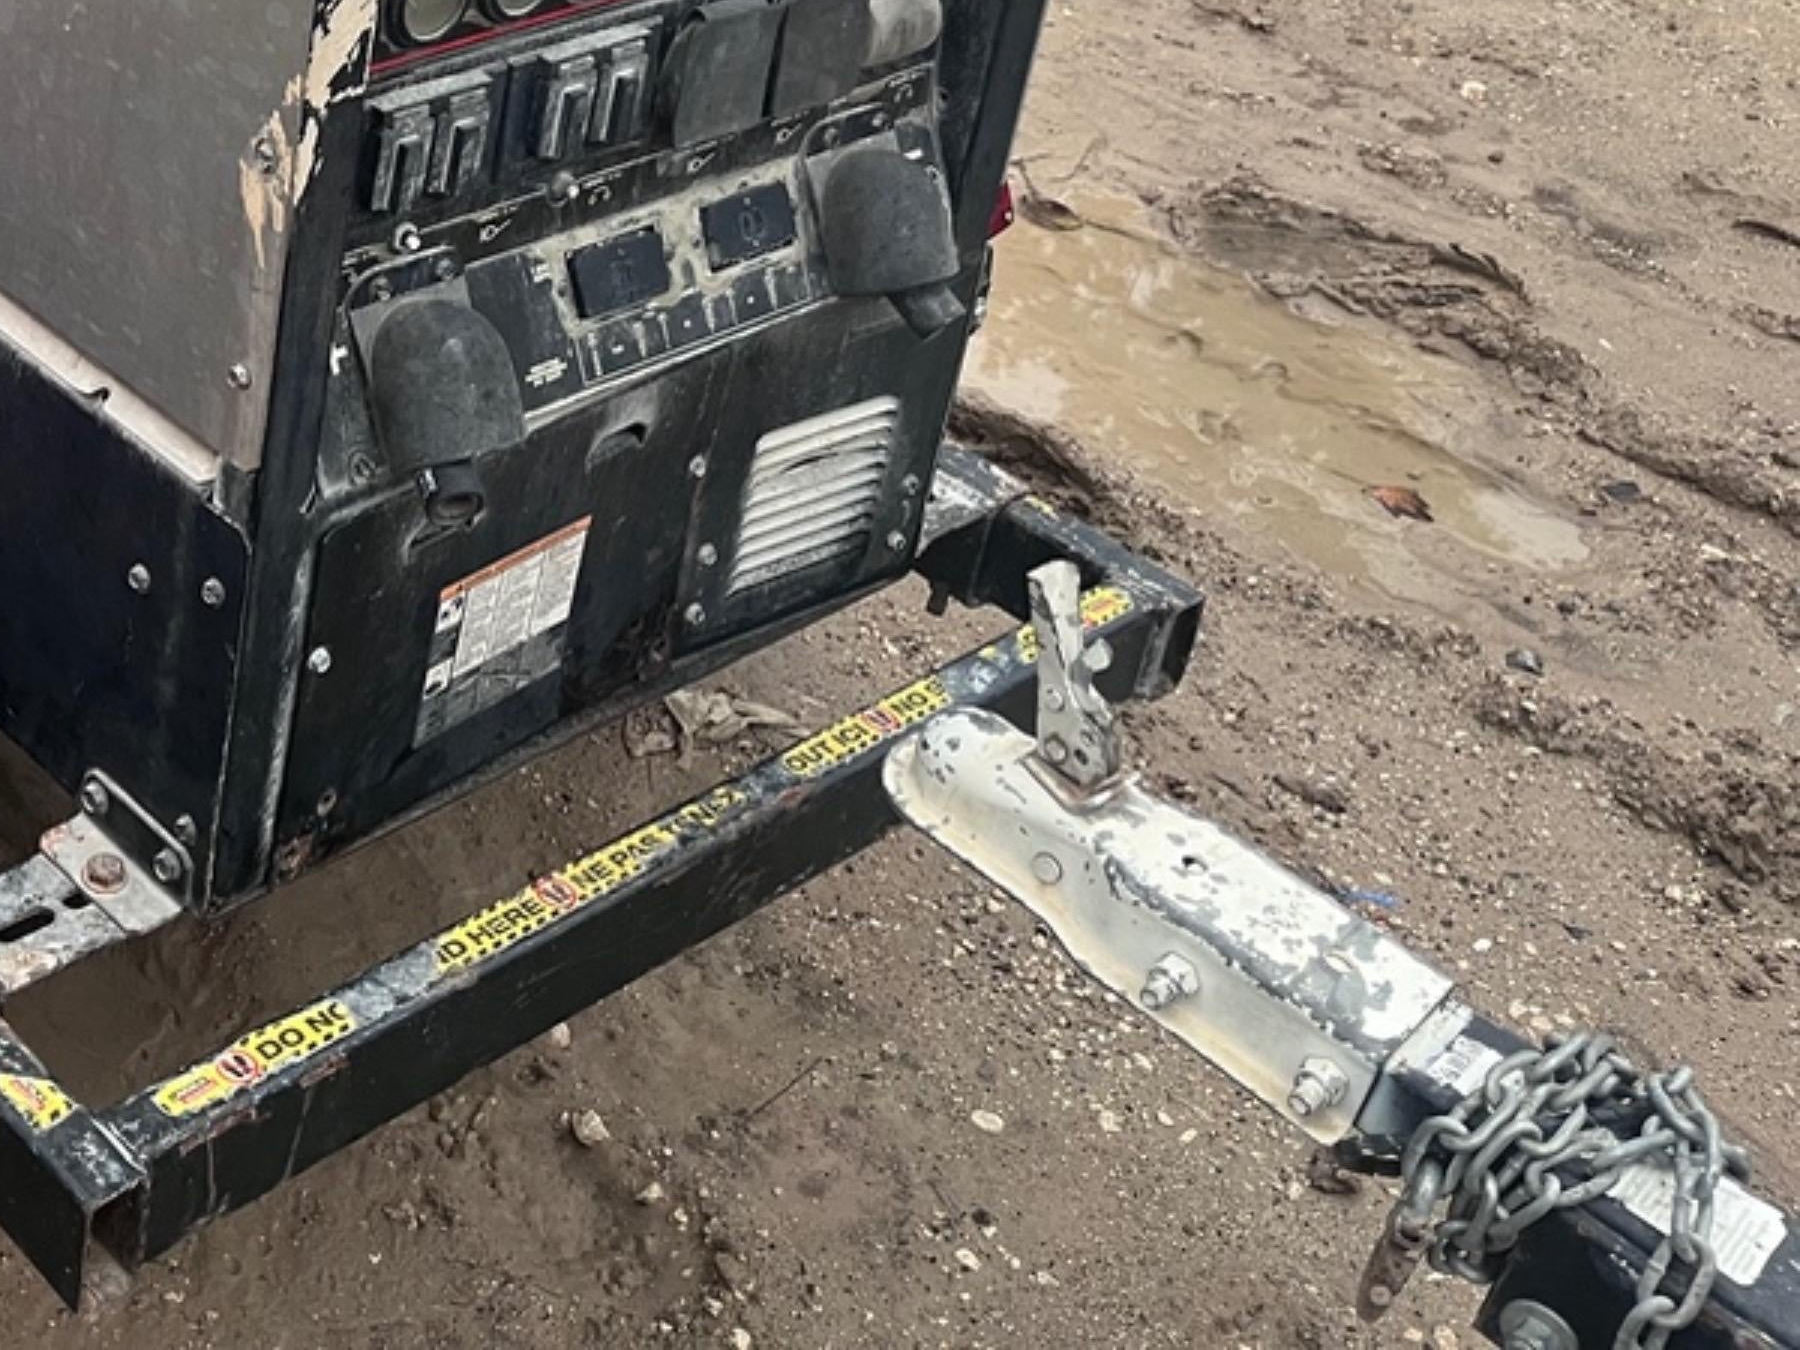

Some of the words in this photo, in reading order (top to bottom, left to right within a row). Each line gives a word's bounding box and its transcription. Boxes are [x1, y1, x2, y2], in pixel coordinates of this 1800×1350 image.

[889, 692, 929, 717] NO
[831, 722, 871, 748] ICI
[569, 861, 614, 892] NE
[466, 899, 545, 946] HERE
[256, 1026, 305, 1061] DO
